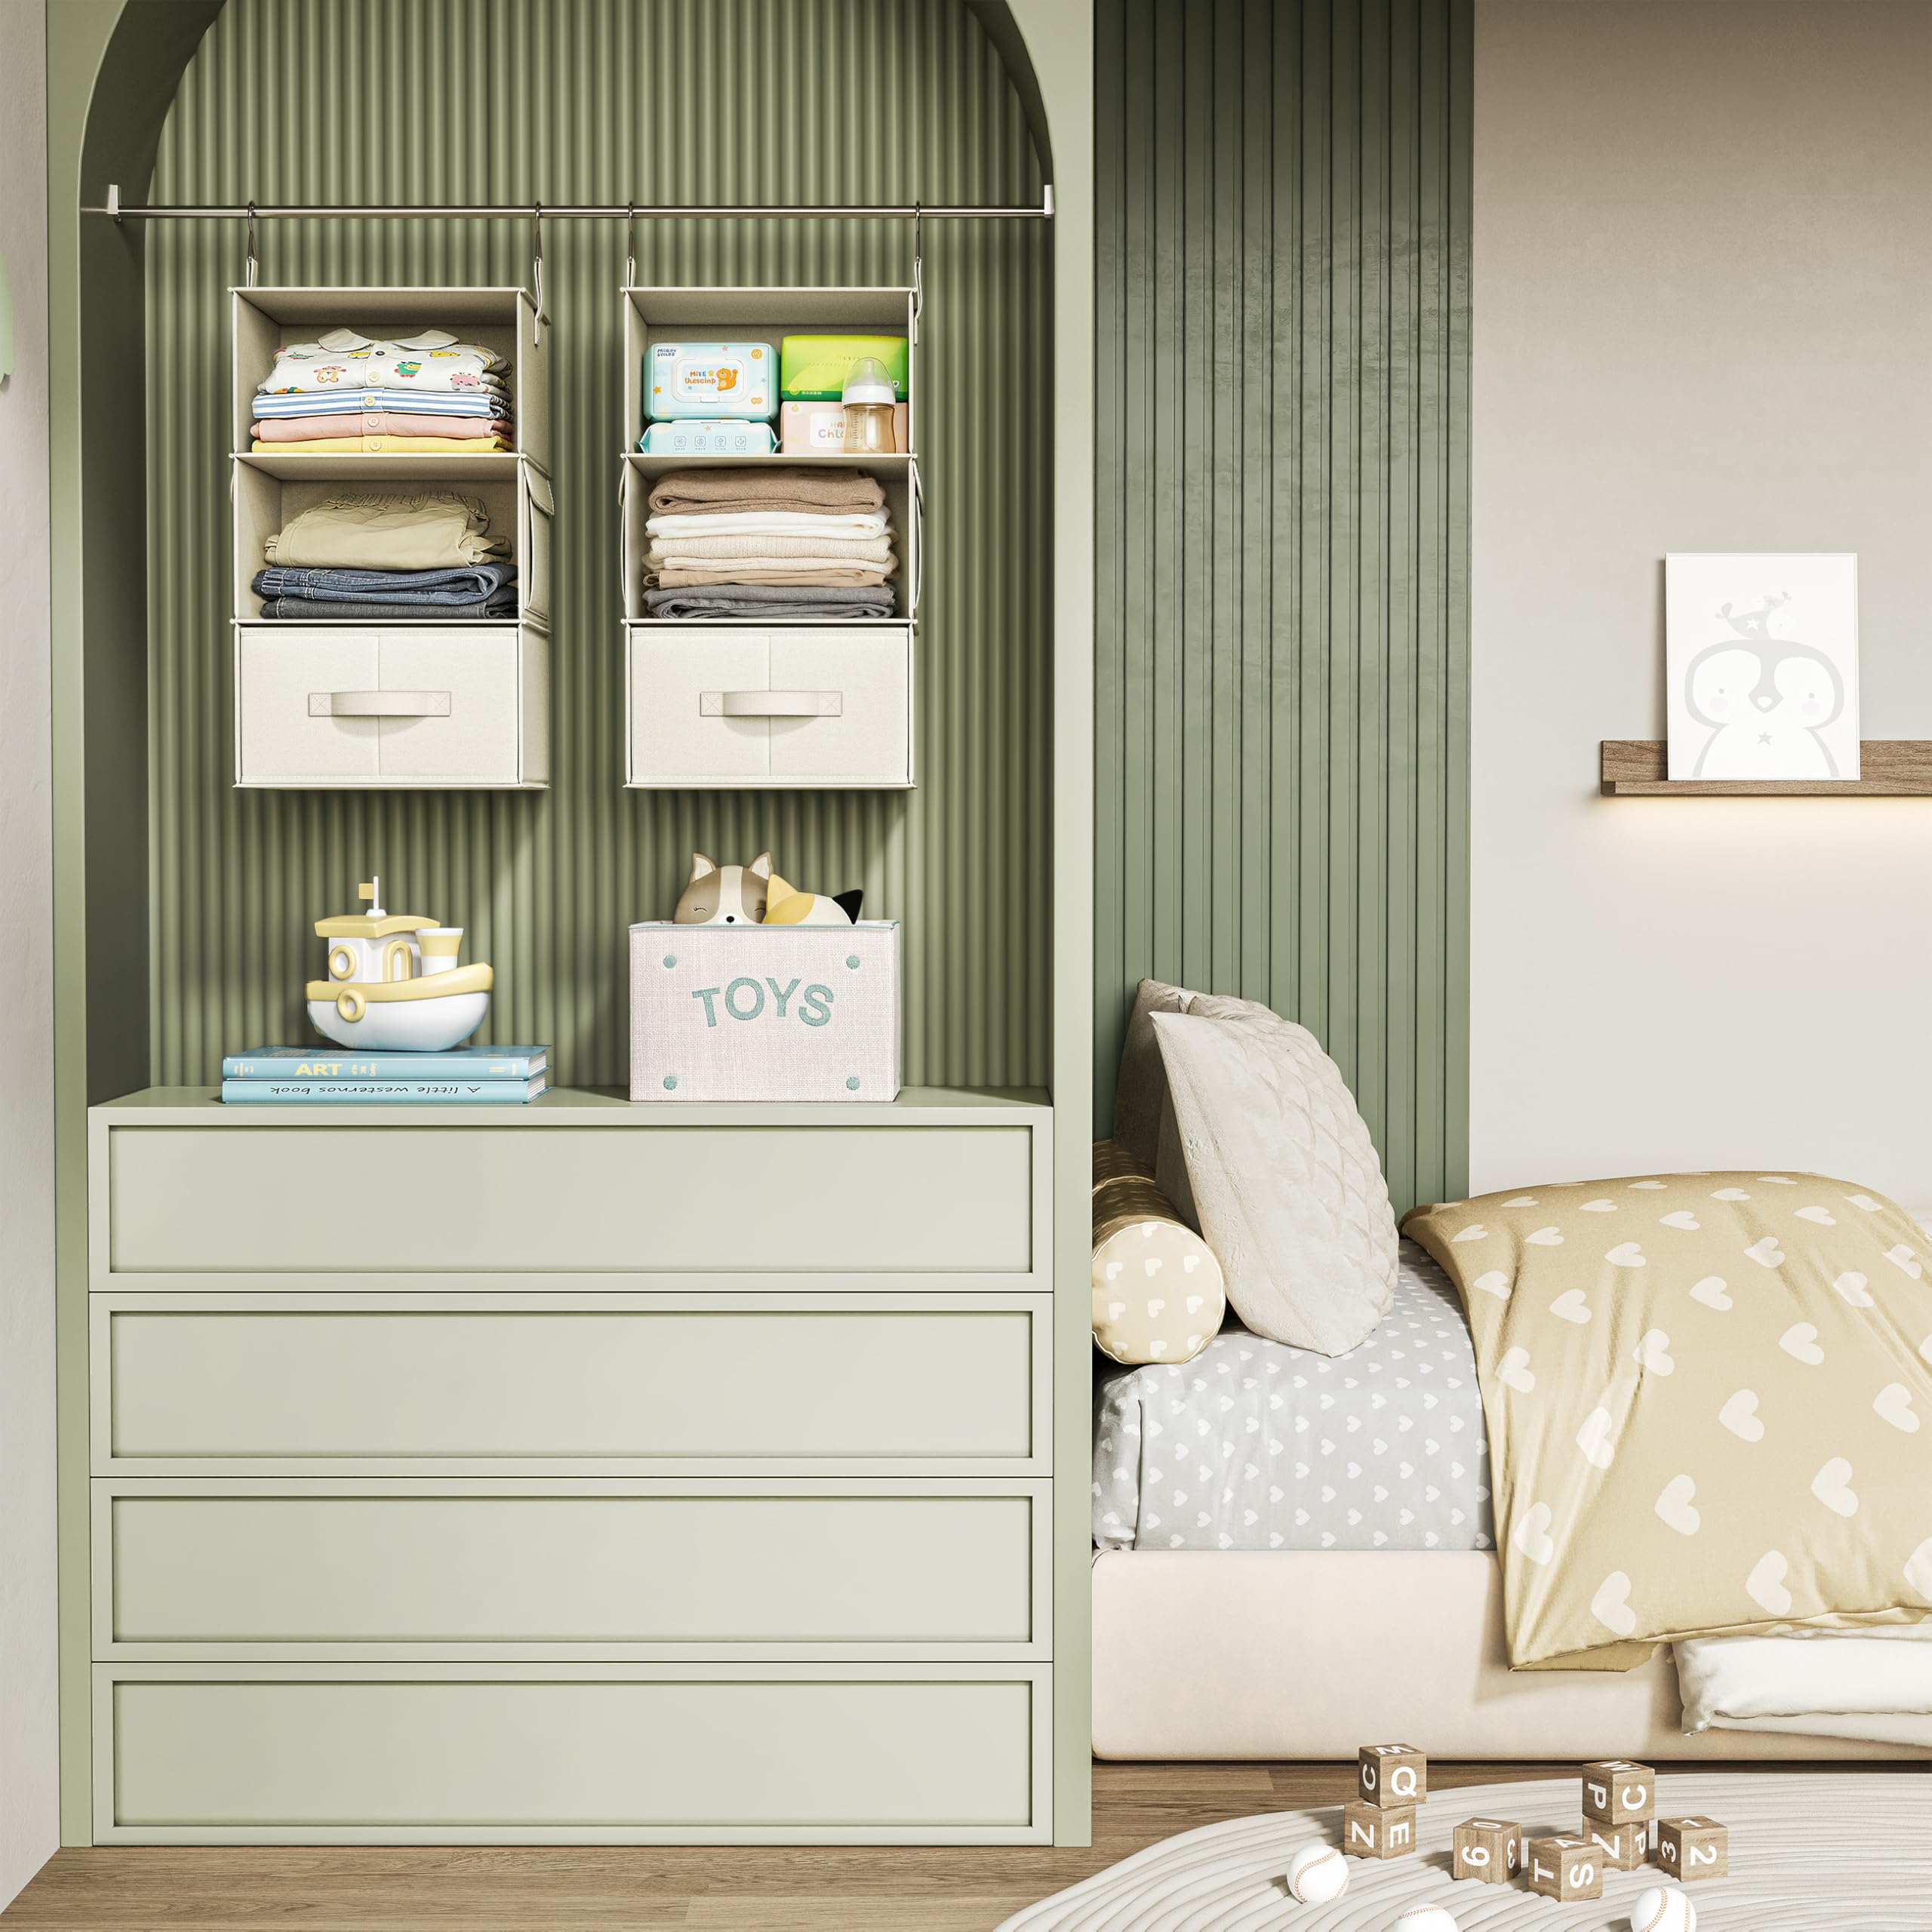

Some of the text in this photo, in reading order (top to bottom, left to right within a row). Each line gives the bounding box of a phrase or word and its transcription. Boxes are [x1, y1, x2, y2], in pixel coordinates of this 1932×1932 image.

[692, 977, 834, 1027] TOYS
[295, 1063, 343, 1075] ART
[1362, 1764, 1376, 1791] C
[1391, 1766, 1417, 1797] Q
[1588, 1783, 1606, 1809] P
[1622, 1785, 1647, 1810] C
[1389, 1823, 1409, 1848] E
[1555, 1839, 1586, 1847] A
[1662, 1841, 1676, 1863] 3
[1690, 1845, 1717, 1866] 2
[1534, 1858, 1554, 1882] T
[1570, 1863, 1594, 1888] S
